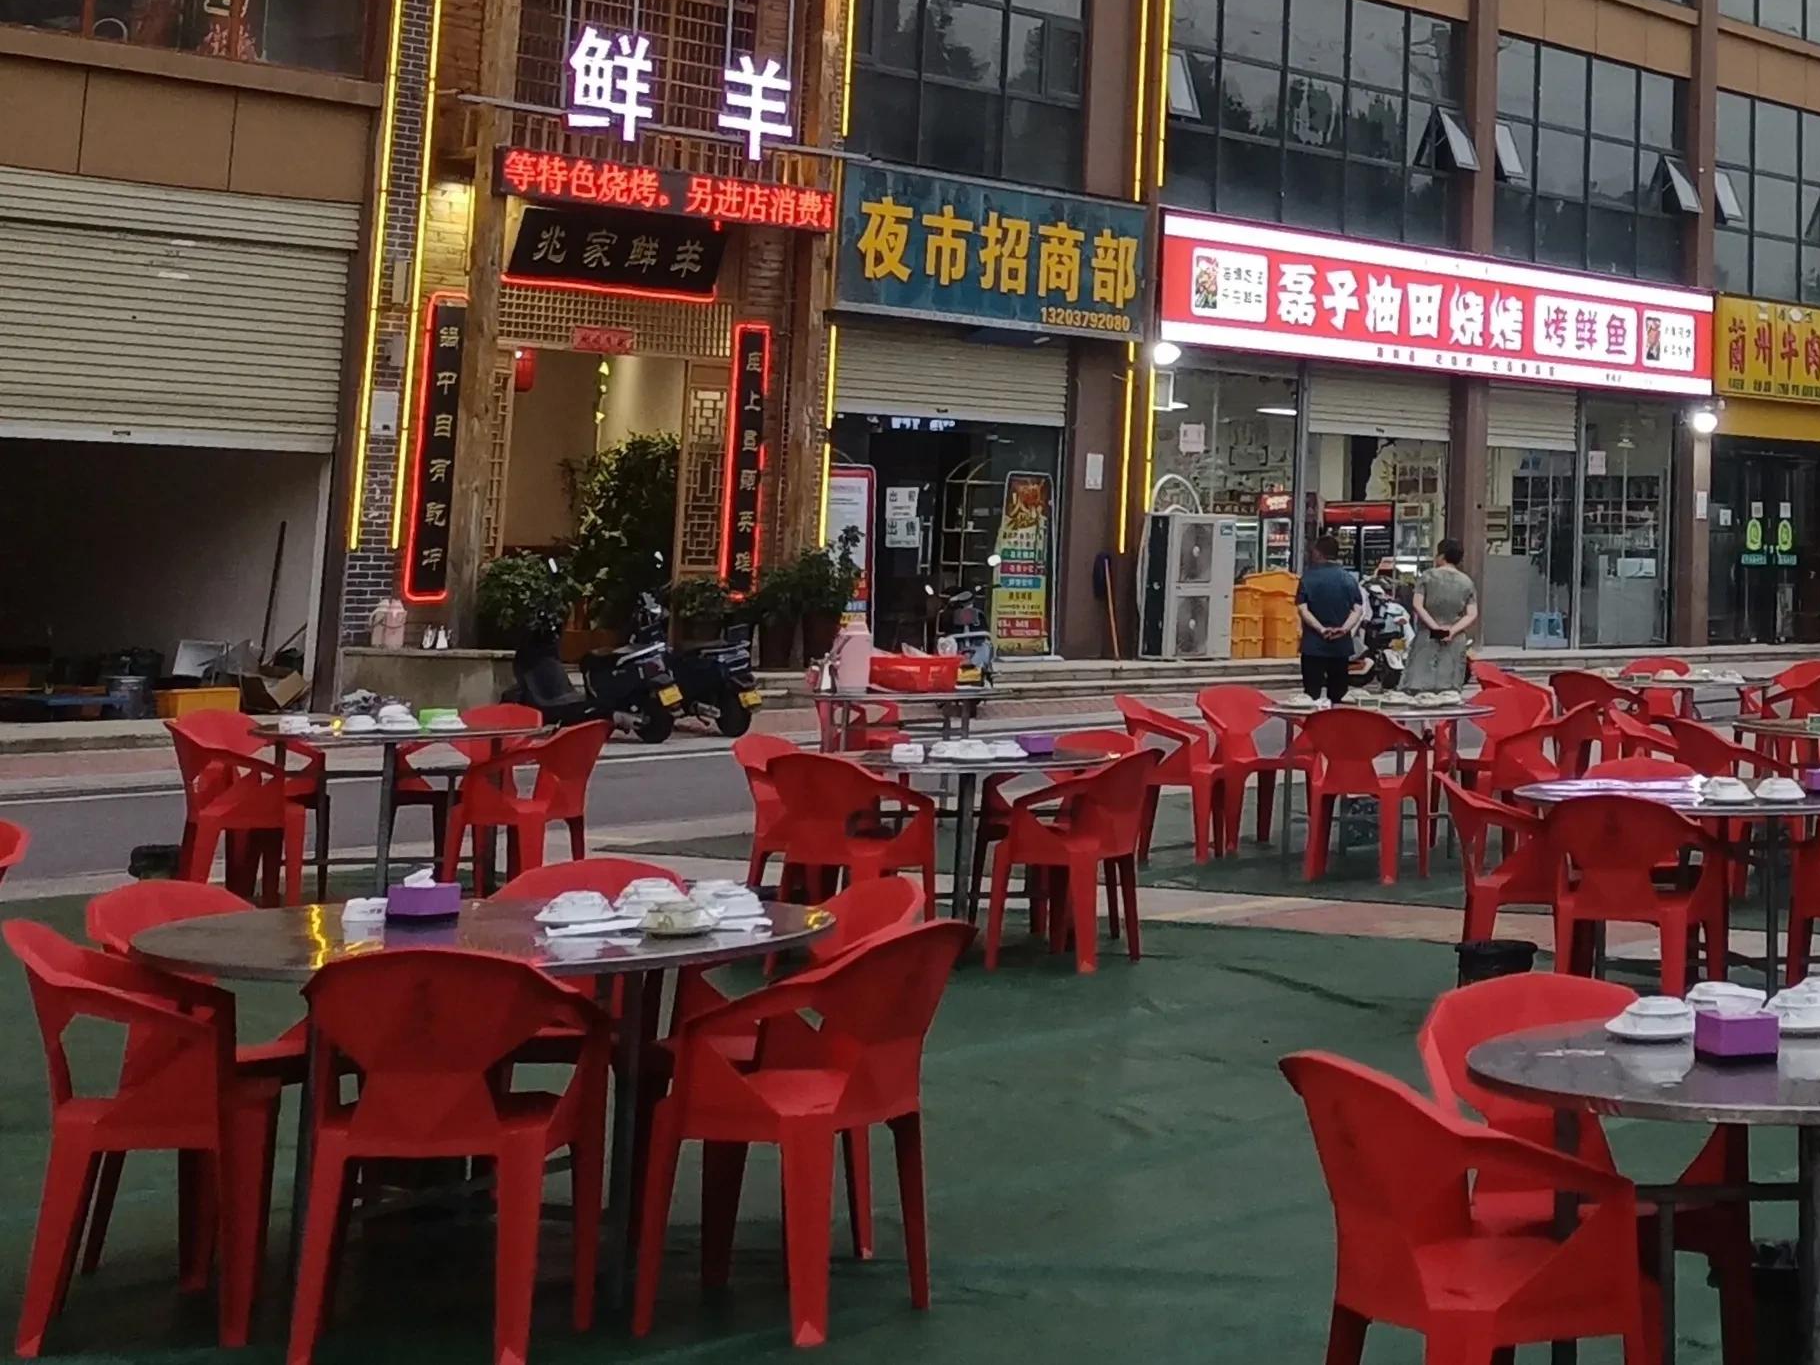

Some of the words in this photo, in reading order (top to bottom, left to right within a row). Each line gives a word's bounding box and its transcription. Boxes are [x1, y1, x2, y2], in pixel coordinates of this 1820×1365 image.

[567, 27, 794, 162] 鲜羊
[857, 196, 1139, 310] 夜市招商部
[1040, 306, 1132, 333] 13203792080
[1543, 304, 1629, 357] 烤鲜鱼
